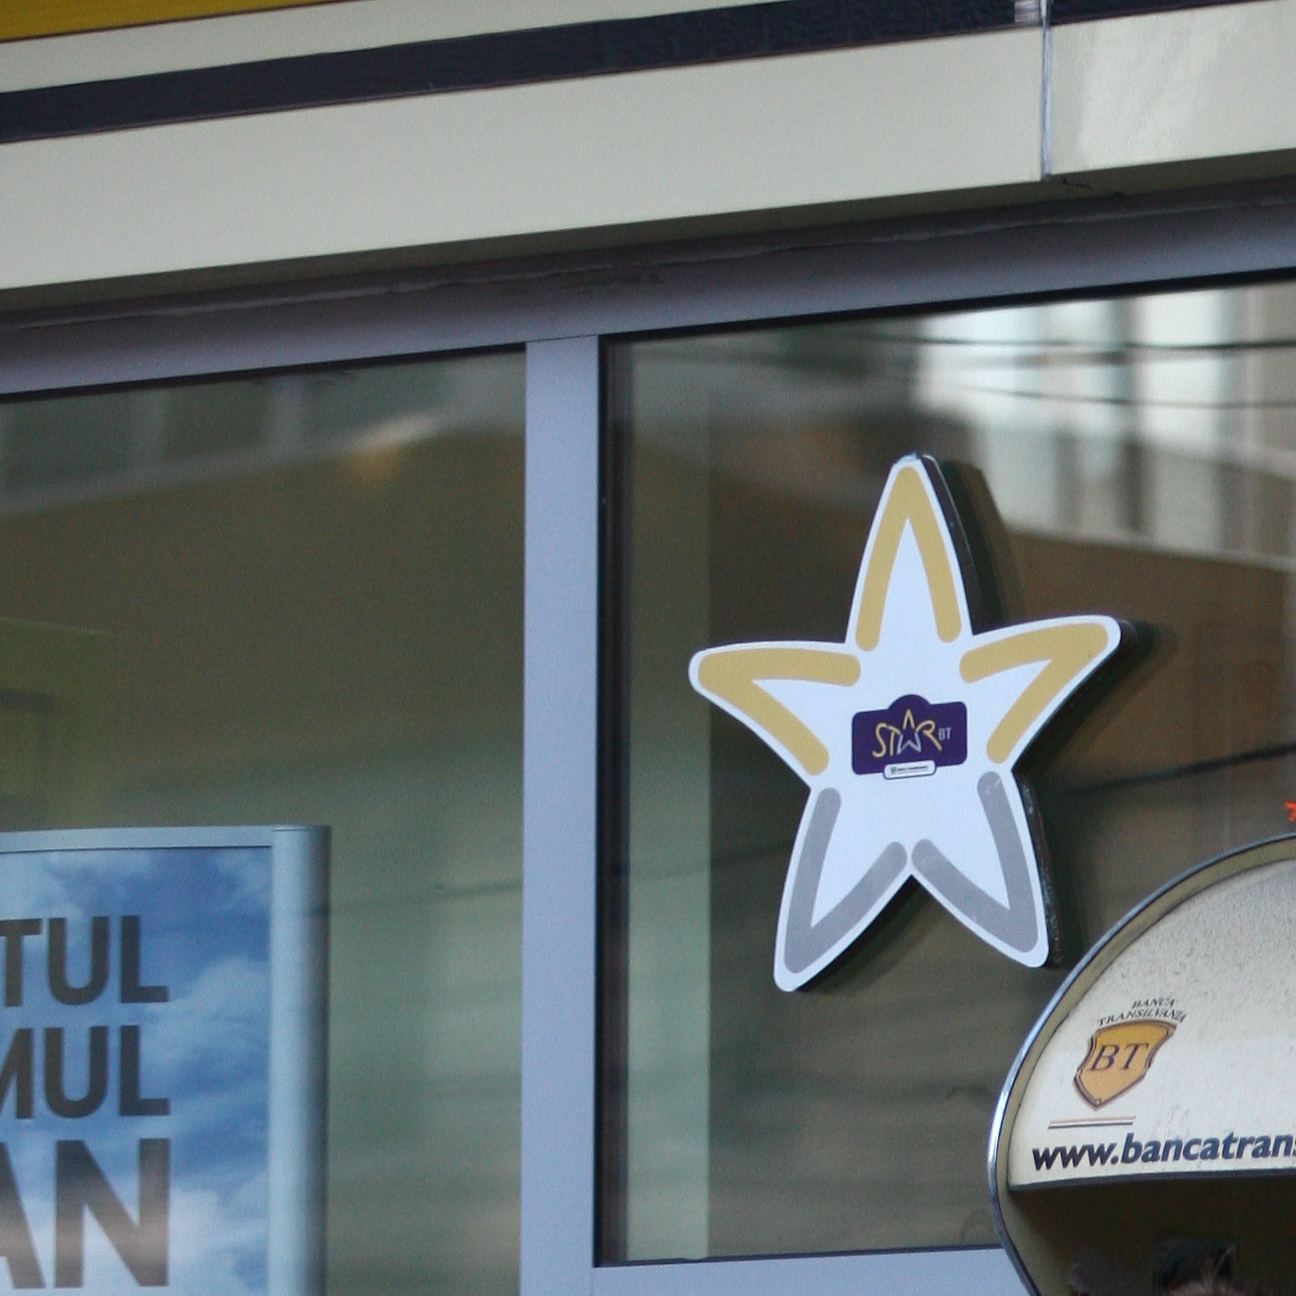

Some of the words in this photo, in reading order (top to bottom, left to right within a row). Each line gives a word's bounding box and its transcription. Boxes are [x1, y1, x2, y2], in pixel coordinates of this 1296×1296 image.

[0, 915, 170, 1007] TUL
[1131, 997, 1176, 1010] BANCA
[1097, 1008, 1187, 1027] TRANSILVANIA
[1089, 1042, 1150, 1071] BT
